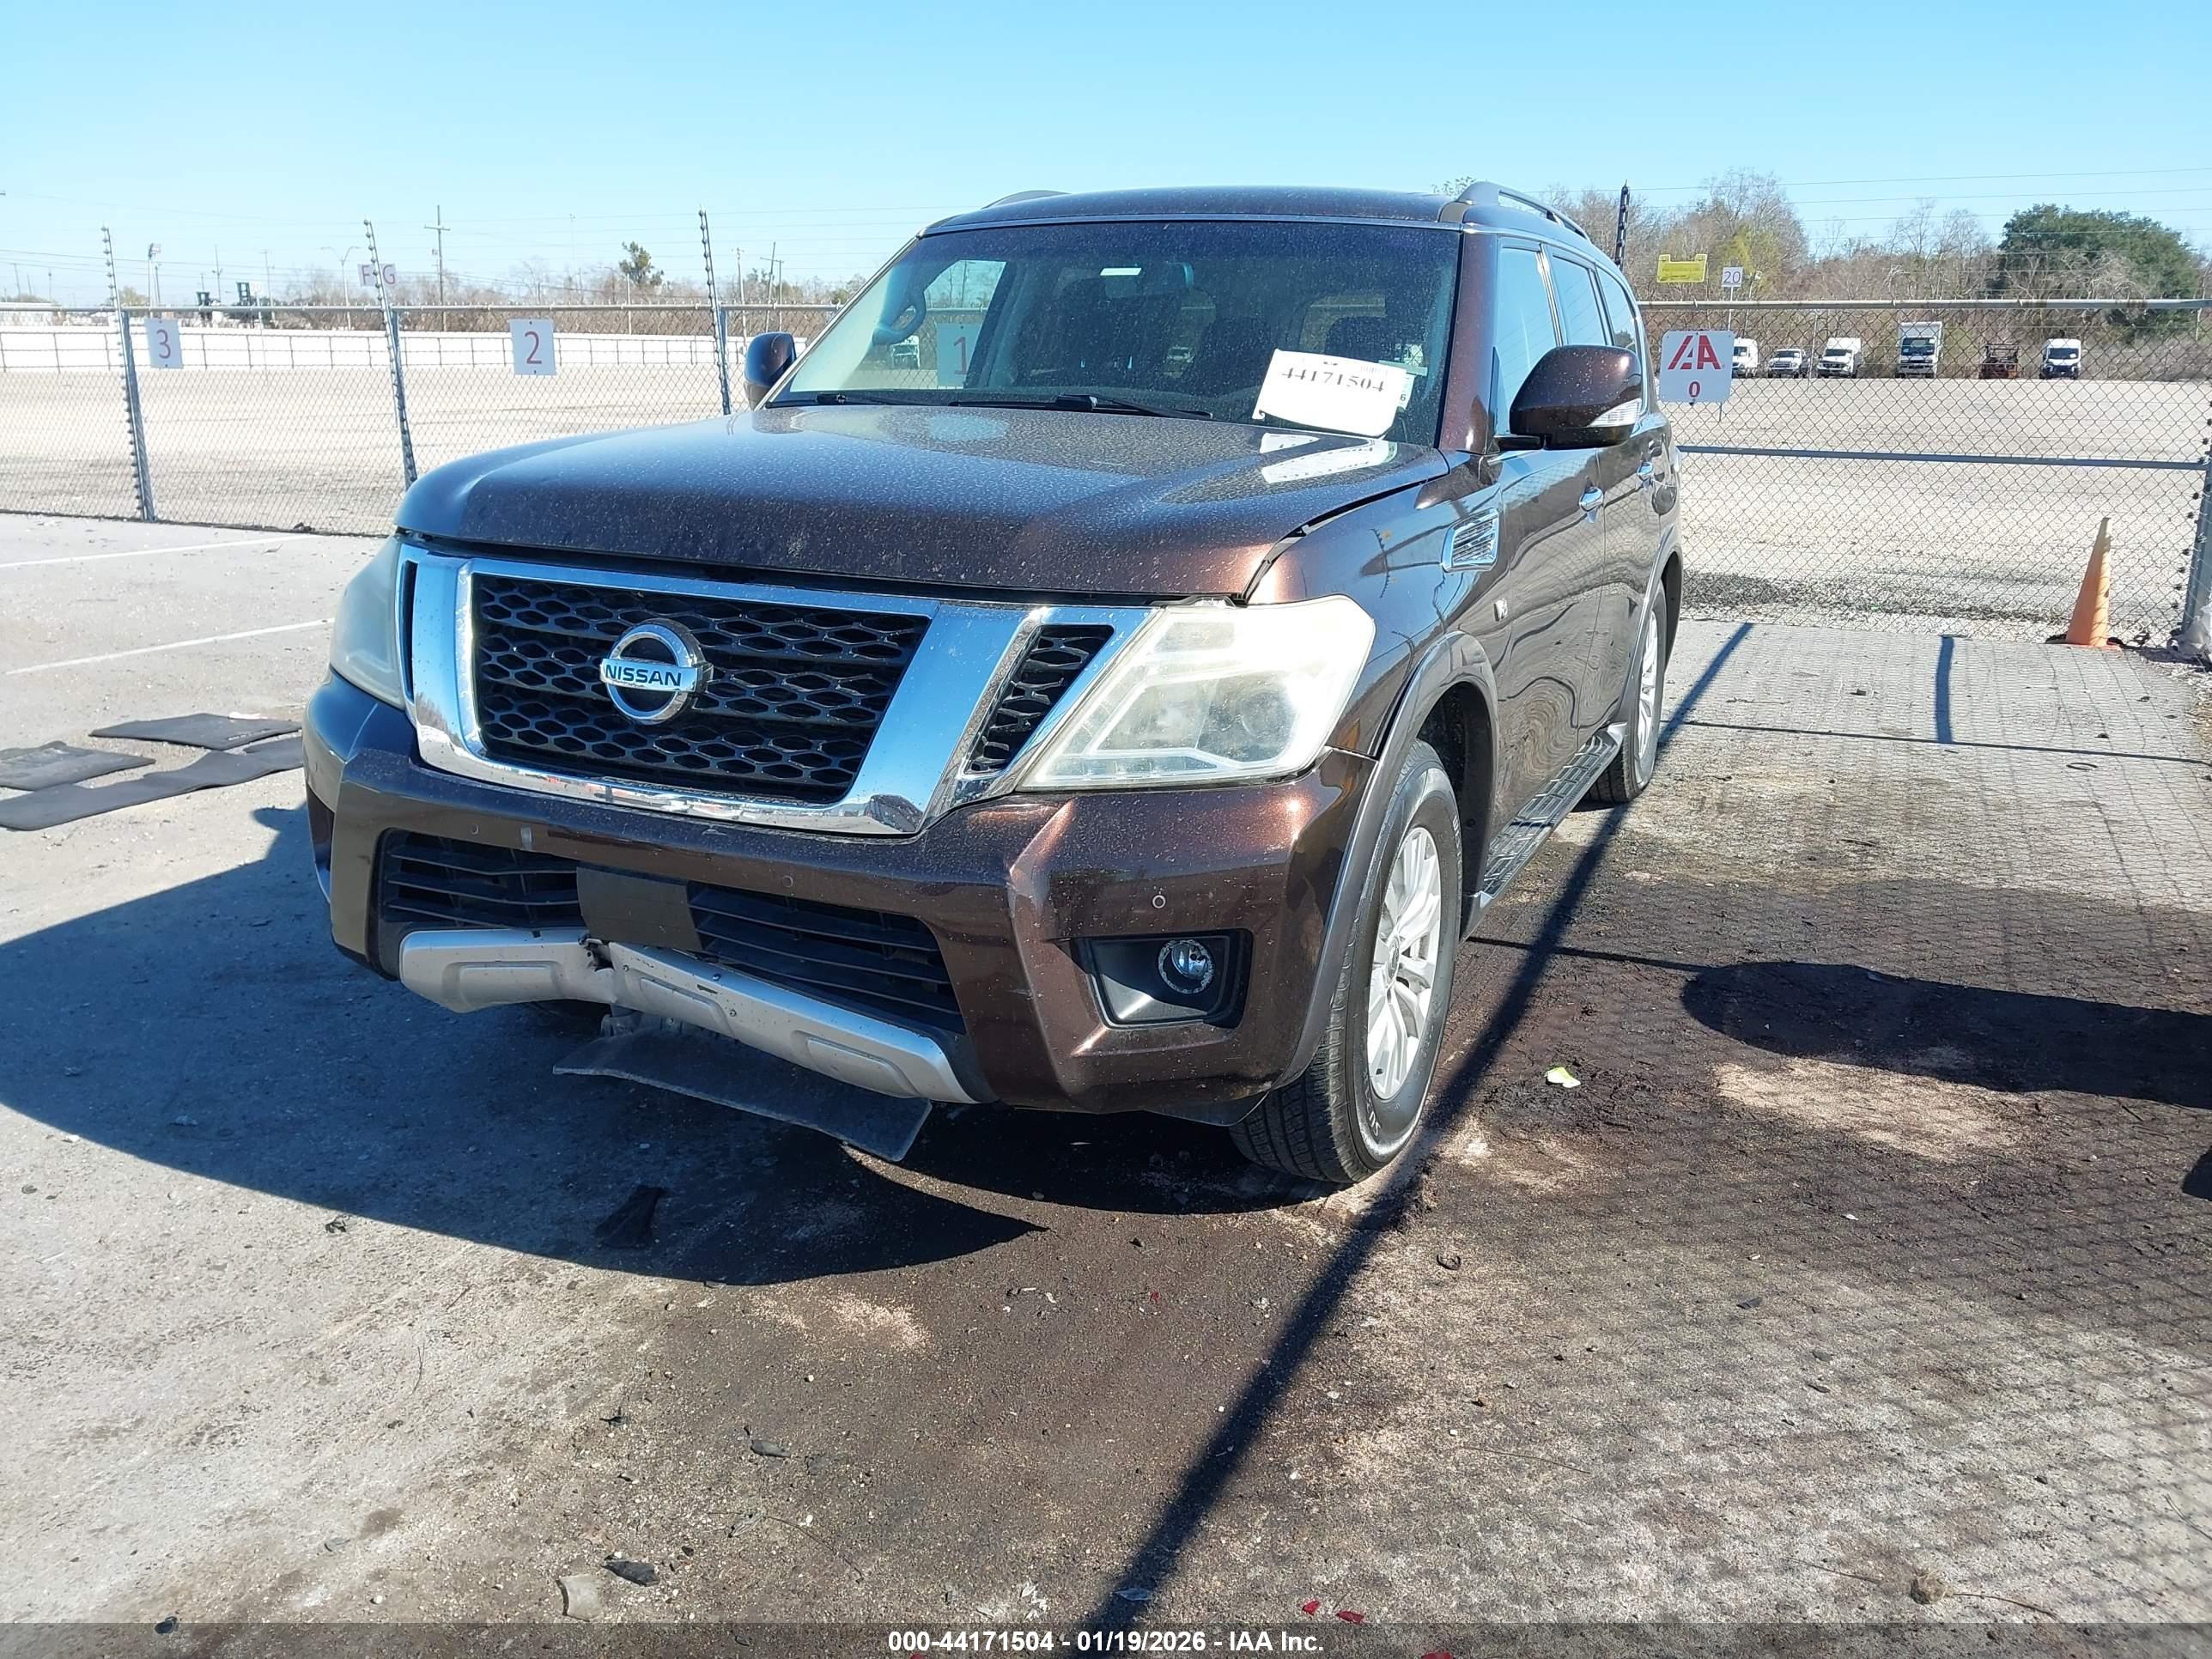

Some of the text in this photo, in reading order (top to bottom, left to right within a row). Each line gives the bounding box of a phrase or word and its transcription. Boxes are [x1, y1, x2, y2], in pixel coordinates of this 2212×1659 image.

[383, 264, 395, 285] G
[1723, 270, 1741, 283] 20
[156, 329, 171, 359] 3
[524, 331, 542, 364] 2
[953, 336, 968, 375] 1
[1282, 367, 1385, 392] 44171504
[1688, 381, 1701, 398] 0
[605, 664, 682, 687] NISSAN
